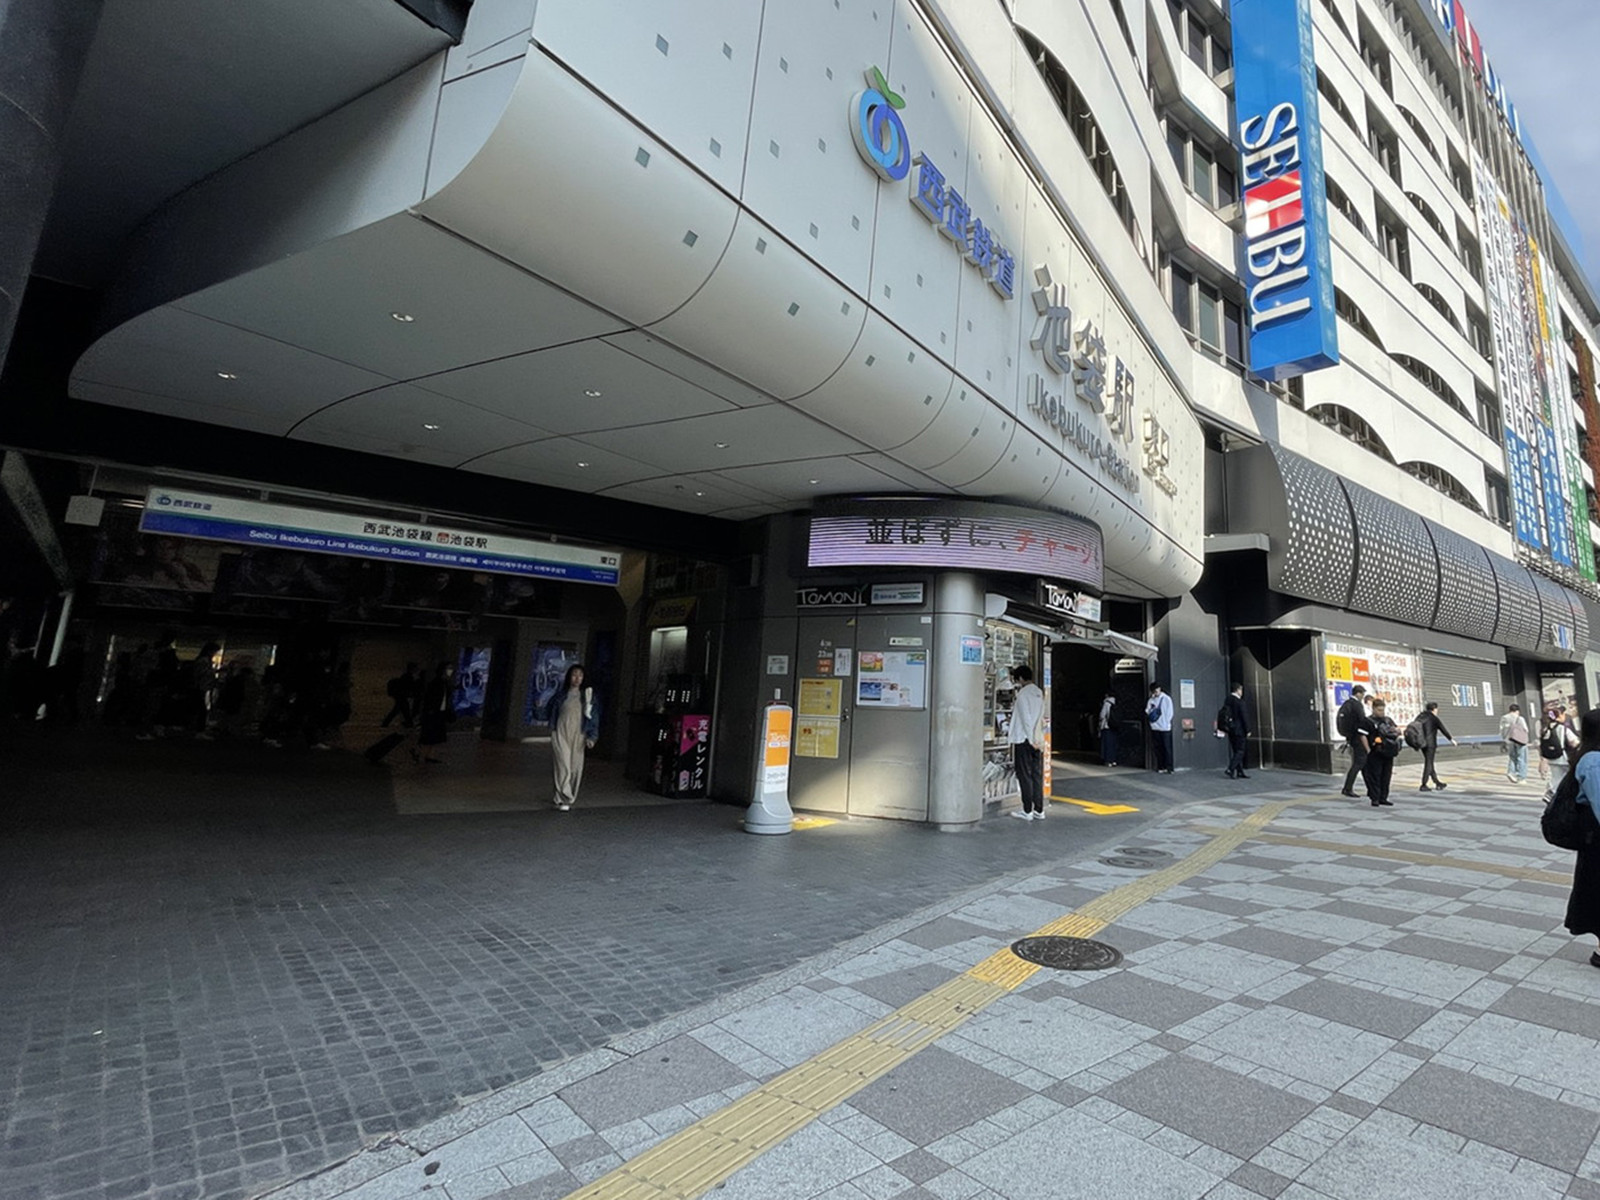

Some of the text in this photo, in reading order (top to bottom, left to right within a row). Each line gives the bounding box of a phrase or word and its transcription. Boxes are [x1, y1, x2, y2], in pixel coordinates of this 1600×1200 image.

[909, 151, 1015, 300] 西武鉄道
[1240, 102, 1310, 333] SEIBU
[1030, 263, 1135, 445] 池袋駅
[249, 529, 420, 558] Seibu Ikebukuro Line Ikebukuro Station
[363, 520, 488, 549] 西武池袋線 池袋駅
[1451, 683, 1478, 707] SEIBU
